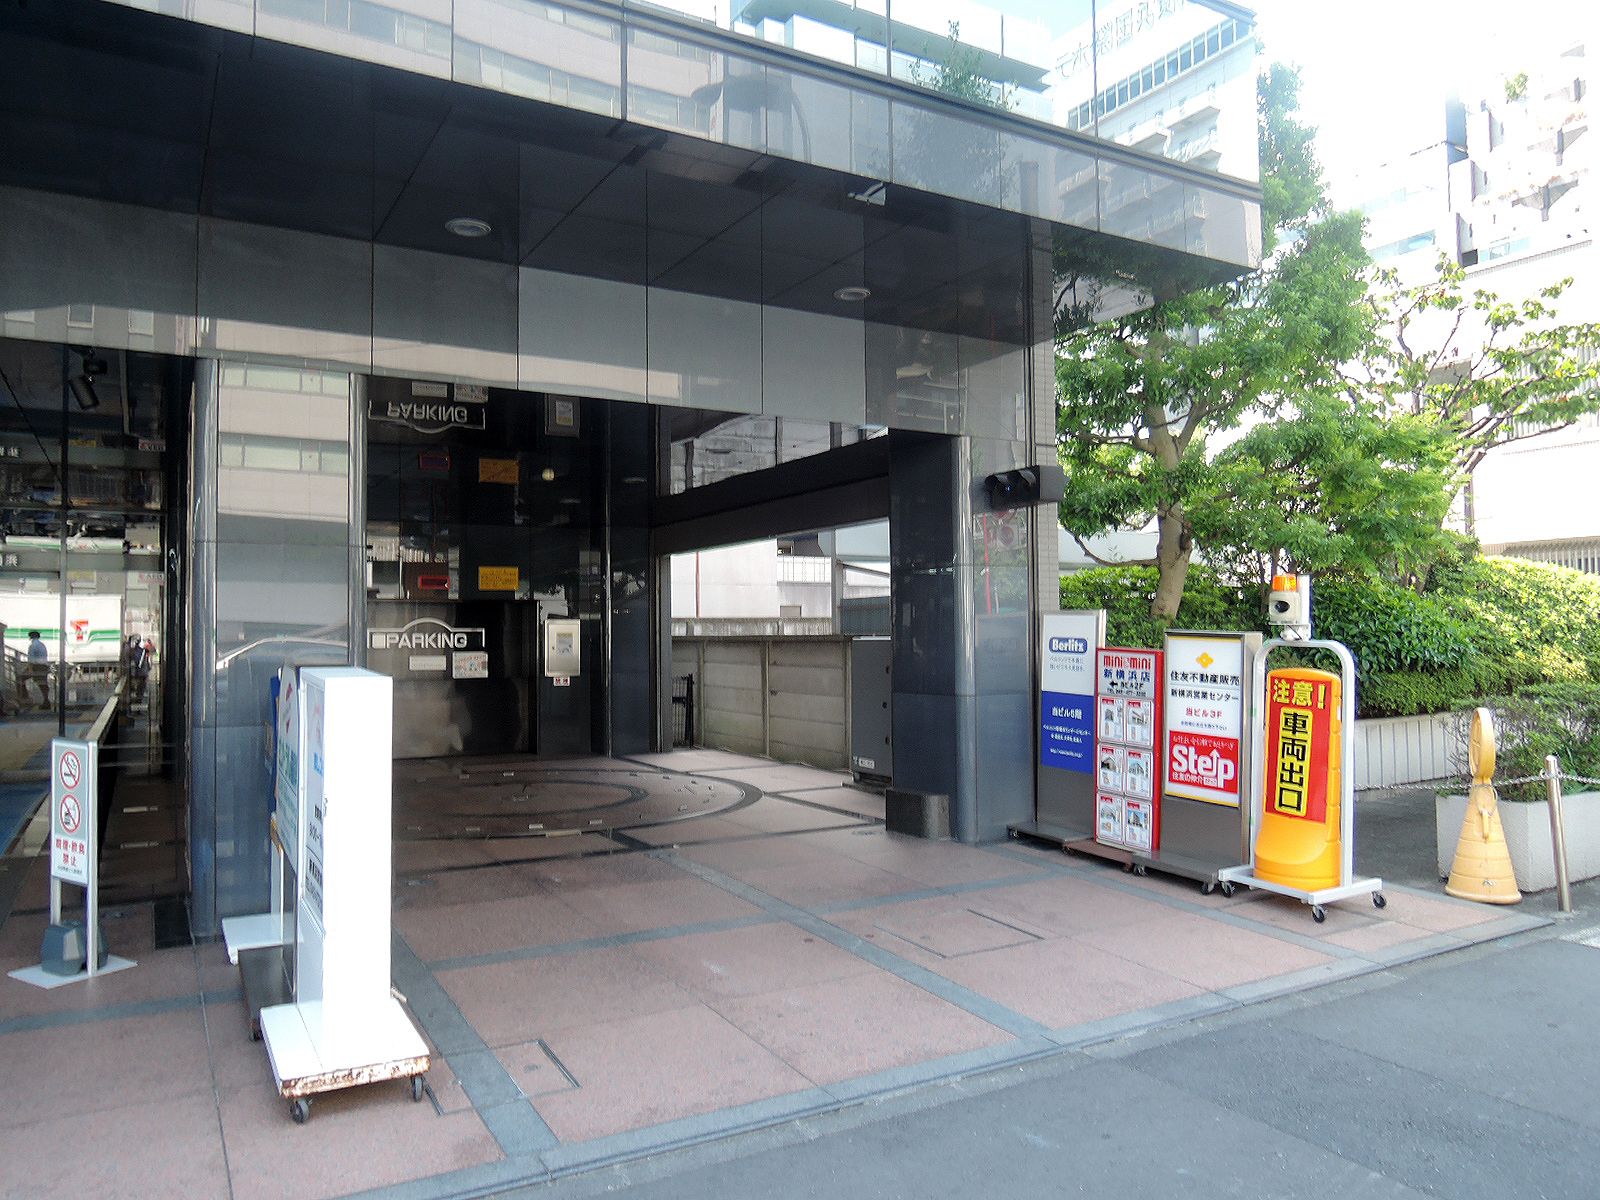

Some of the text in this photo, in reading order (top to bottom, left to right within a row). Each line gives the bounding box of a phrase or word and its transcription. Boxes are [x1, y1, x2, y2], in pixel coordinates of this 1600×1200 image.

[386, 632, 467, 649] PARKING
[1052, 638, 1084, 653] Berlitz
[1103, 655, 1151, 670] mini mini
[1103, 668, 1151, 682] 新横浜店
[1170, 670, 1240, 686] 住友不動産販売
[1171, 688, 1239, 702] 新横浜営業センター
[1185, 707, 1223, 718] 当ビル3F
[1172, 744, 1235, 789] Step
[1278, 711, 1309, 813] 車両出口
